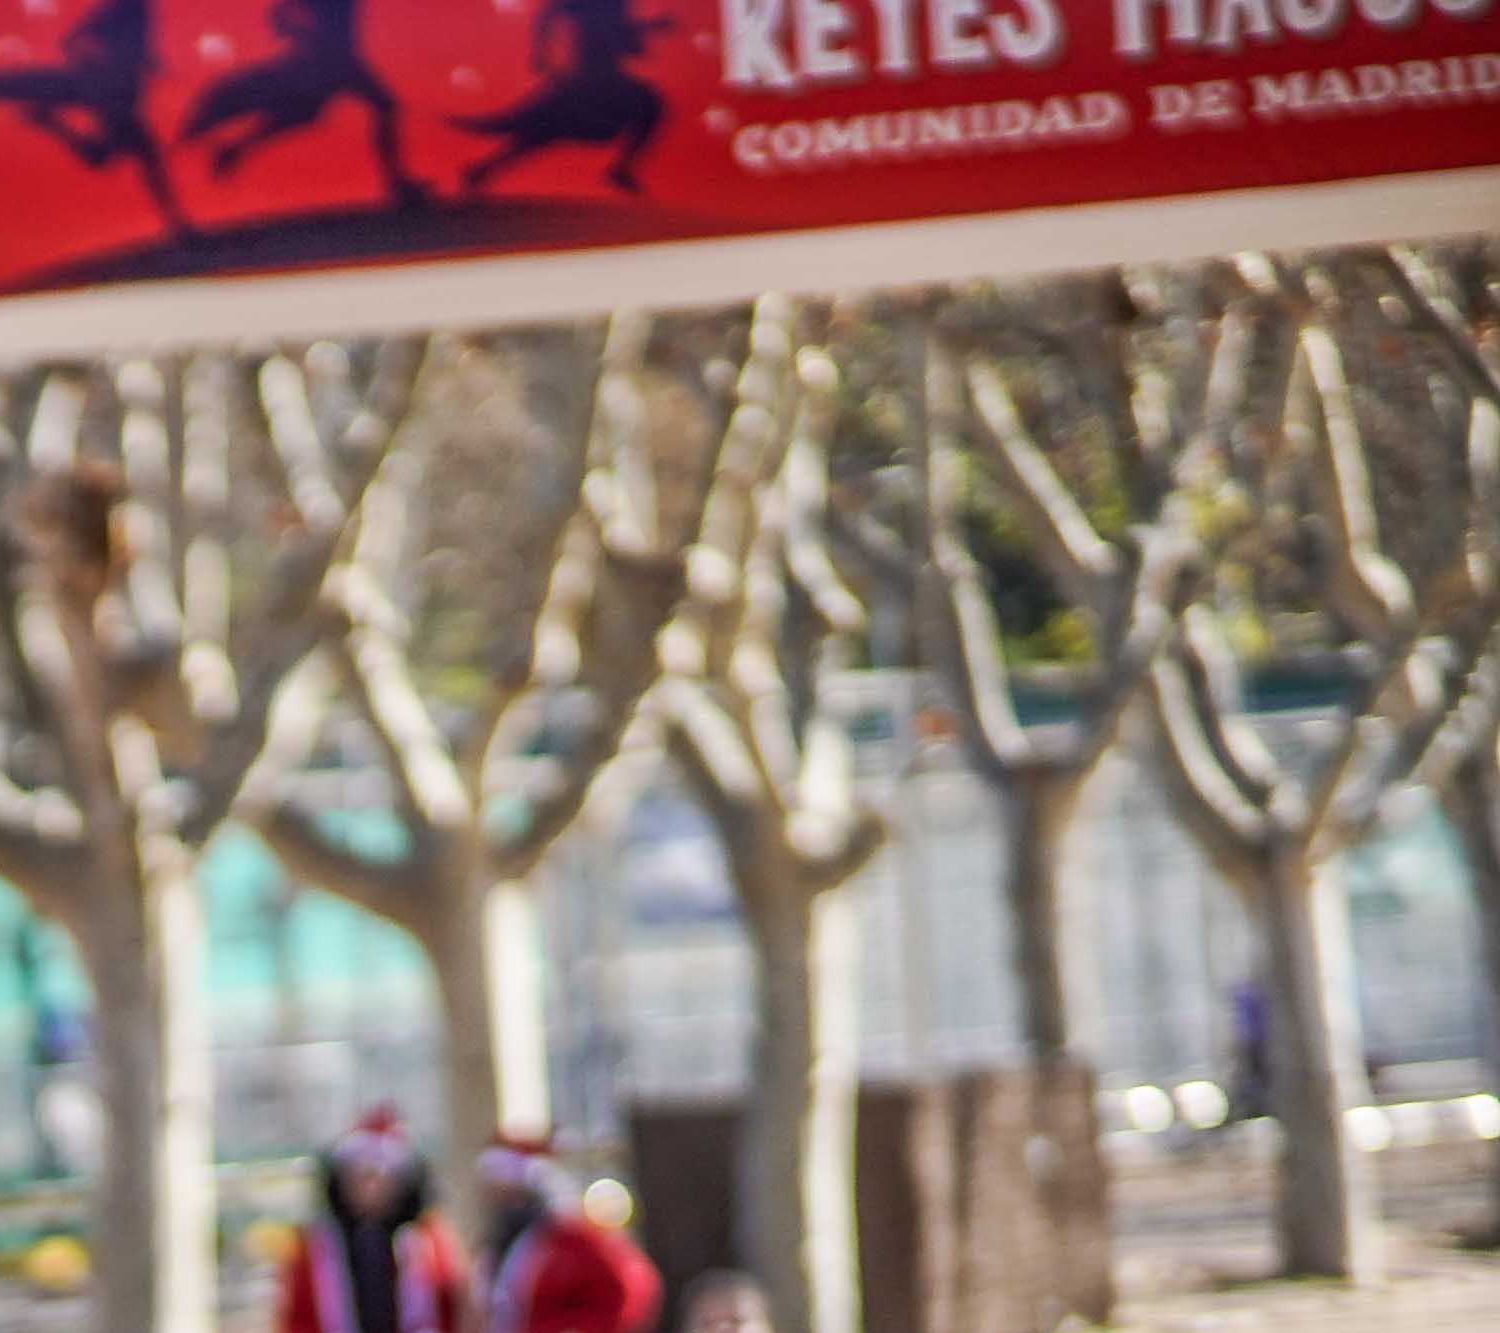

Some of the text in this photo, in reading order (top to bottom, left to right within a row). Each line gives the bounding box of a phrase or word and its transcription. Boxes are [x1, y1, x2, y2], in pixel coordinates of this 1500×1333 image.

[731, 53, 1500, 168] COMUNIDAD DE MADRID
